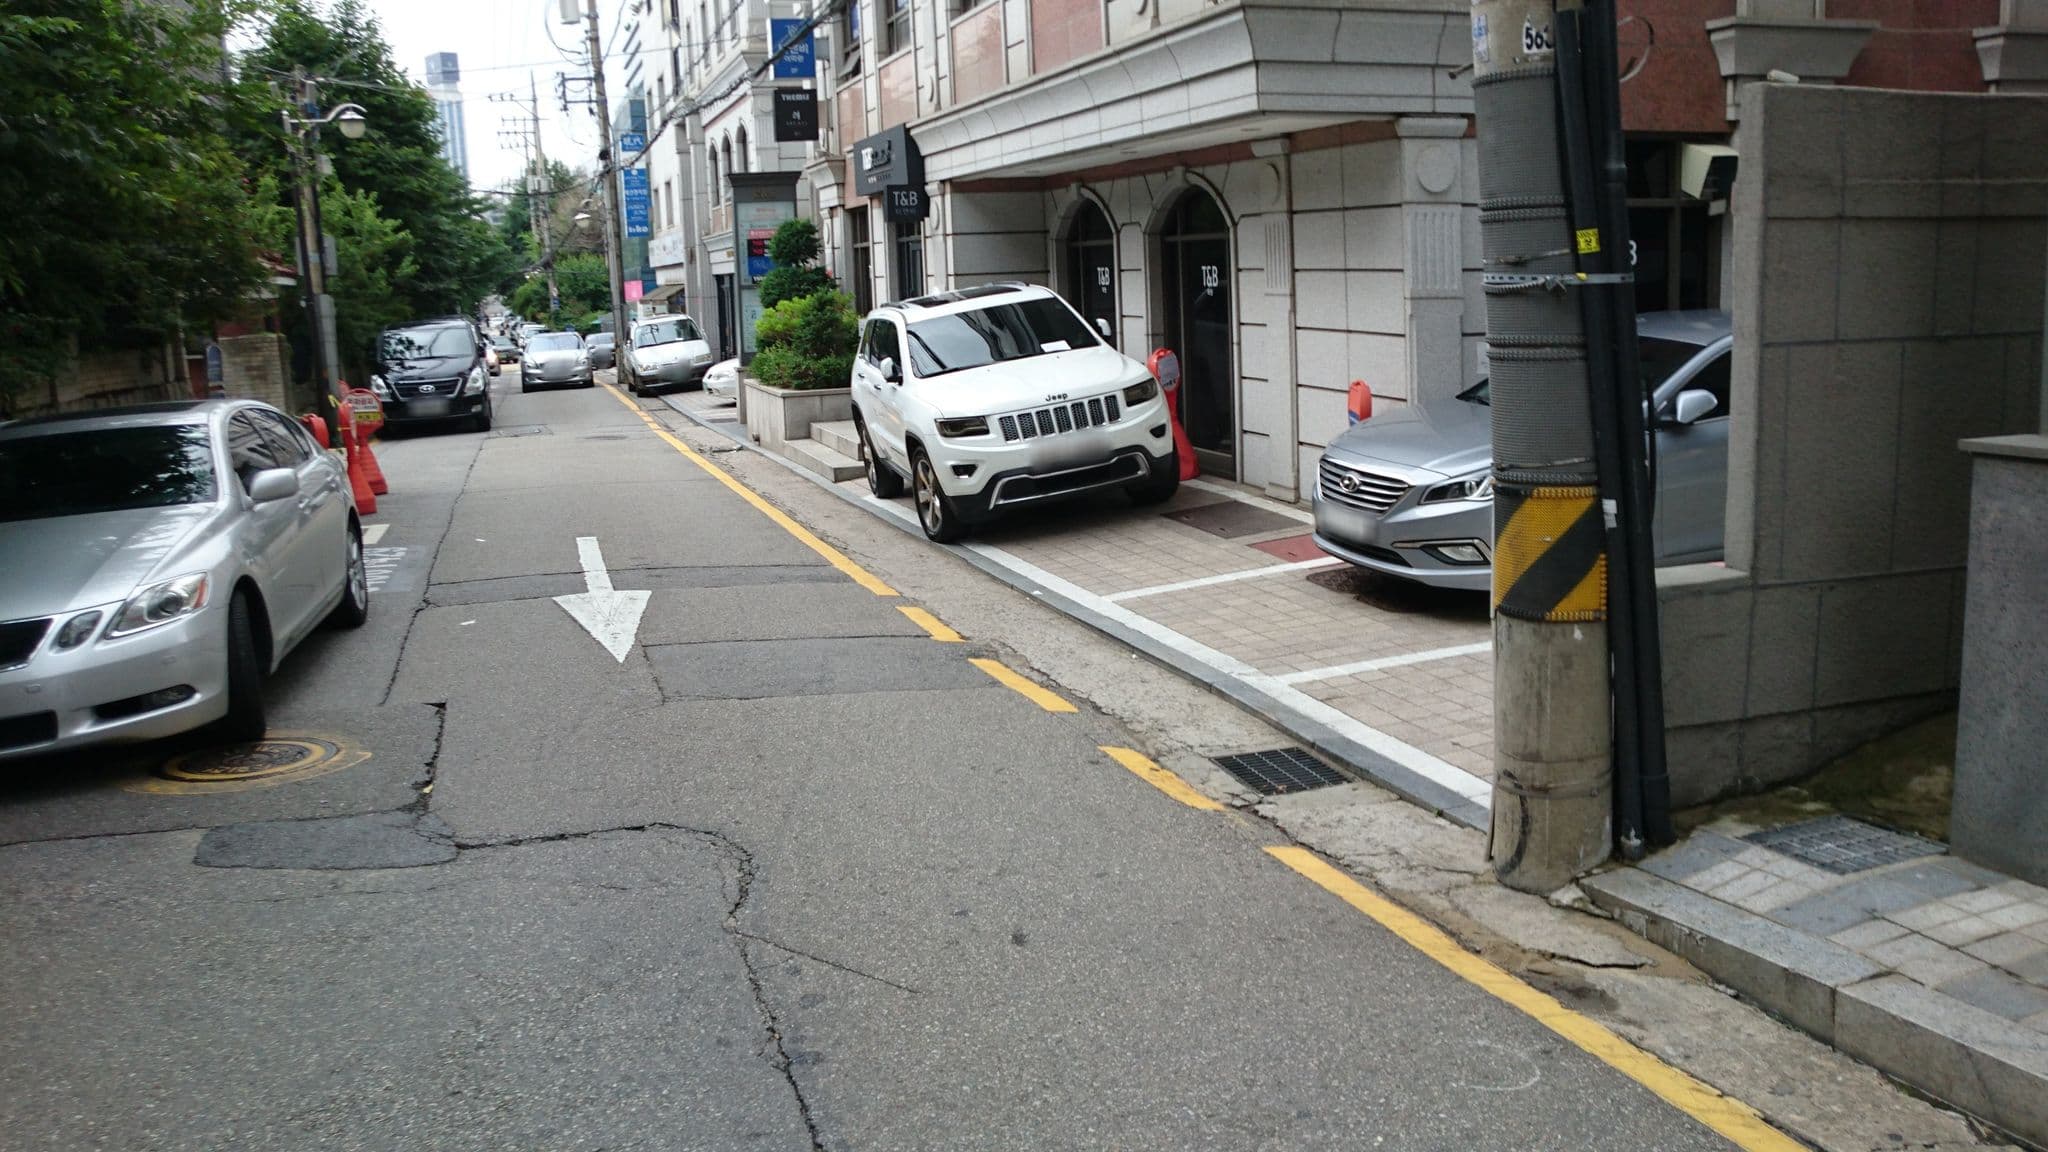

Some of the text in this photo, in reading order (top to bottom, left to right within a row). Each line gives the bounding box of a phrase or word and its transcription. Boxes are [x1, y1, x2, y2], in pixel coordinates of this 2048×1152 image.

[893, 191, 918, 206] T&B
[1097, 267, 1110, 285] T&B
[1201, 266, 1219, 287] T&B
[1045, 393, 1068, 401] Jeep
